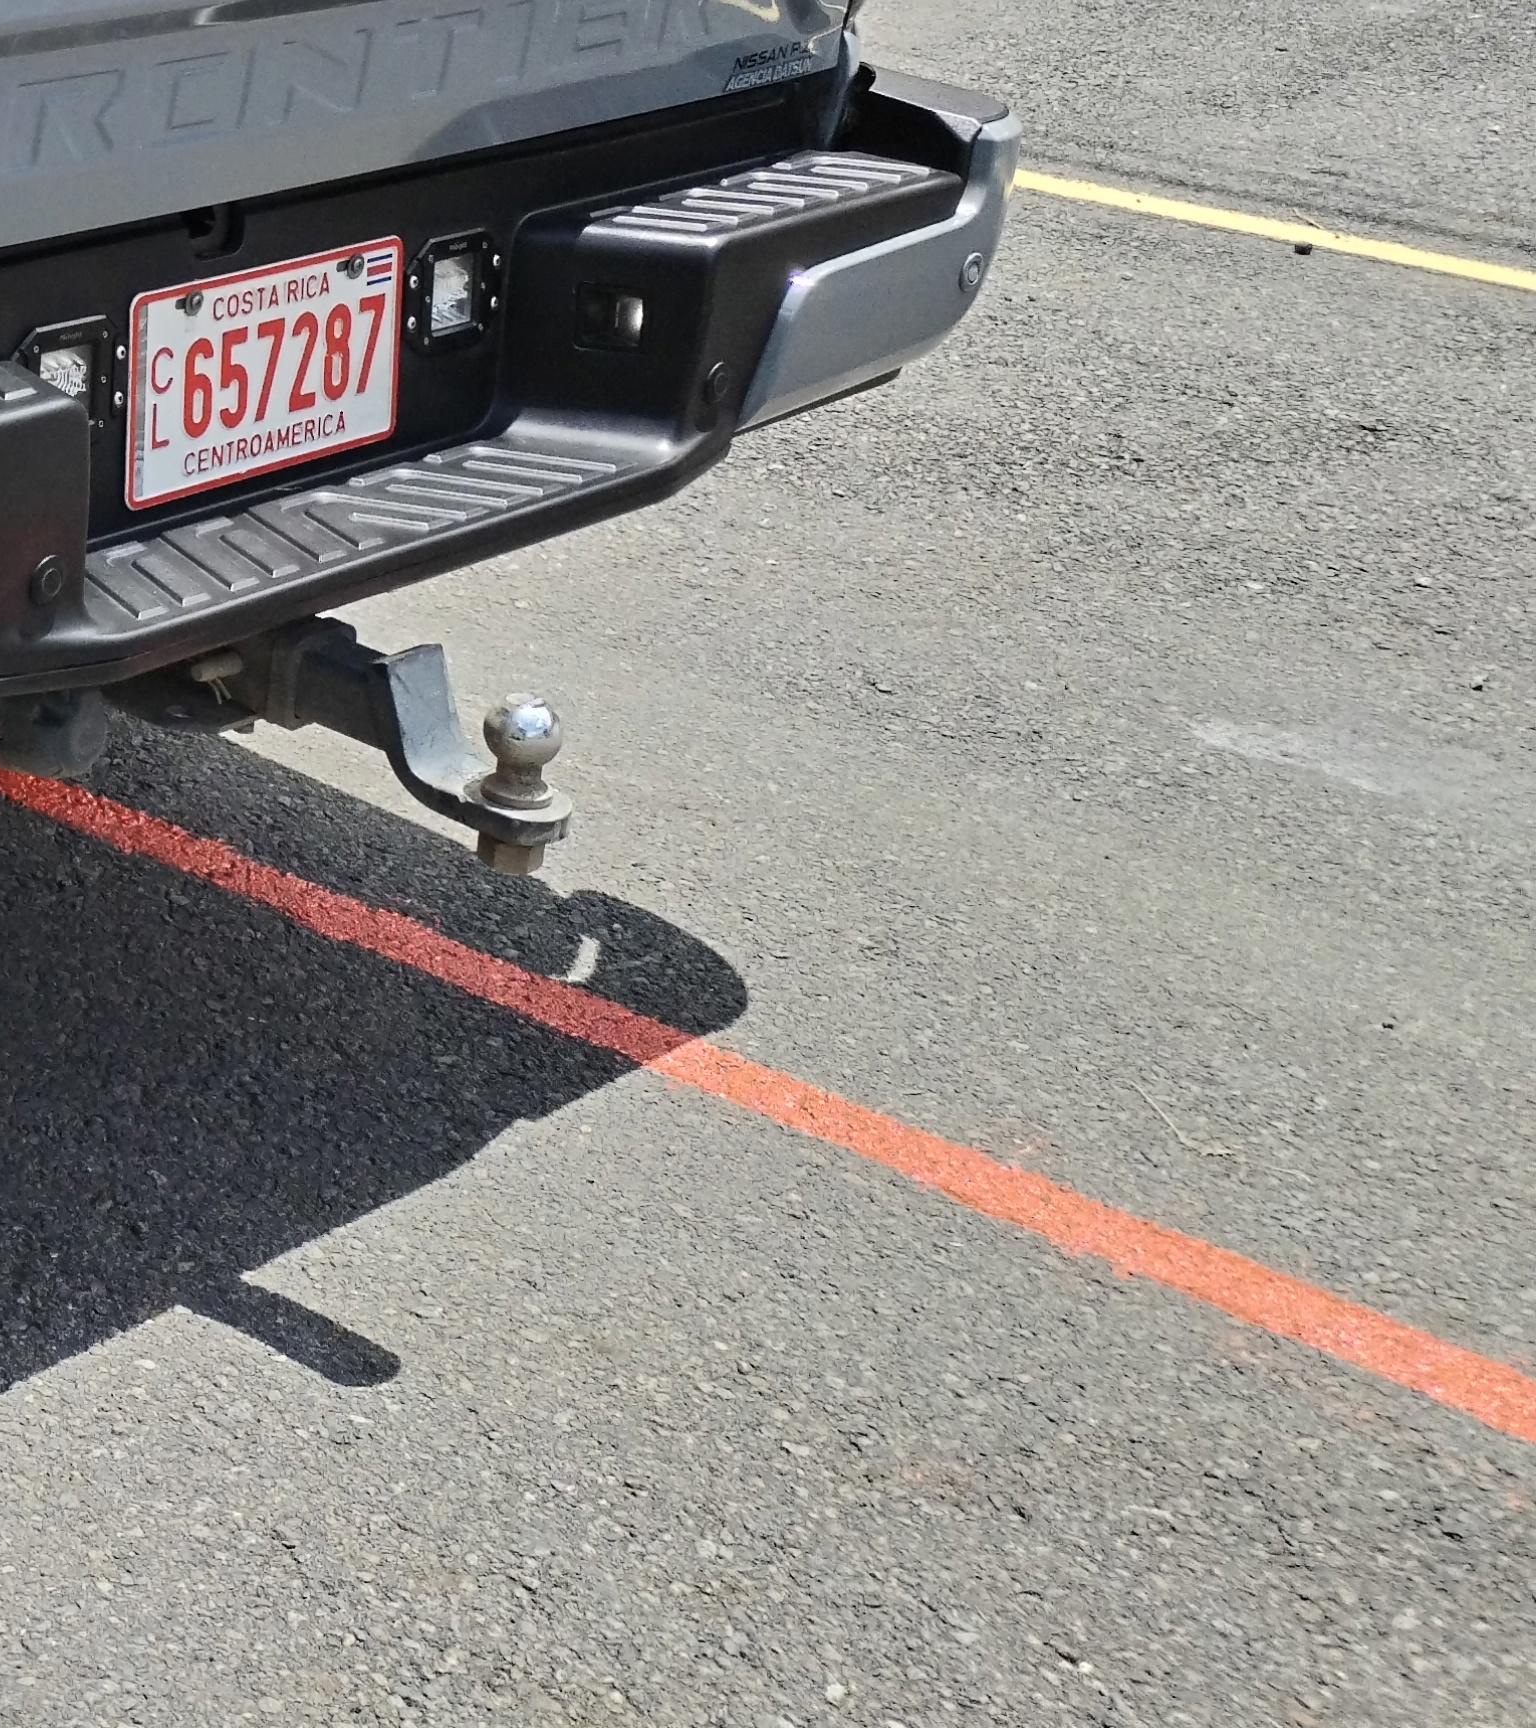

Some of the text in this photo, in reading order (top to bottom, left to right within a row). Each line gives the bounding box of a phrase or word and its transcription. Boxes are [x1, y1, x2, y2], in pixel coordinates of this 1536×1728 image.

[733, 45, 788, 71] NISSAN
[212, 272, 330, 321] COSTA RICA
[182, 293, 387, 439] 657287
[183, 411, 346, 476] CENTROAMERICA
